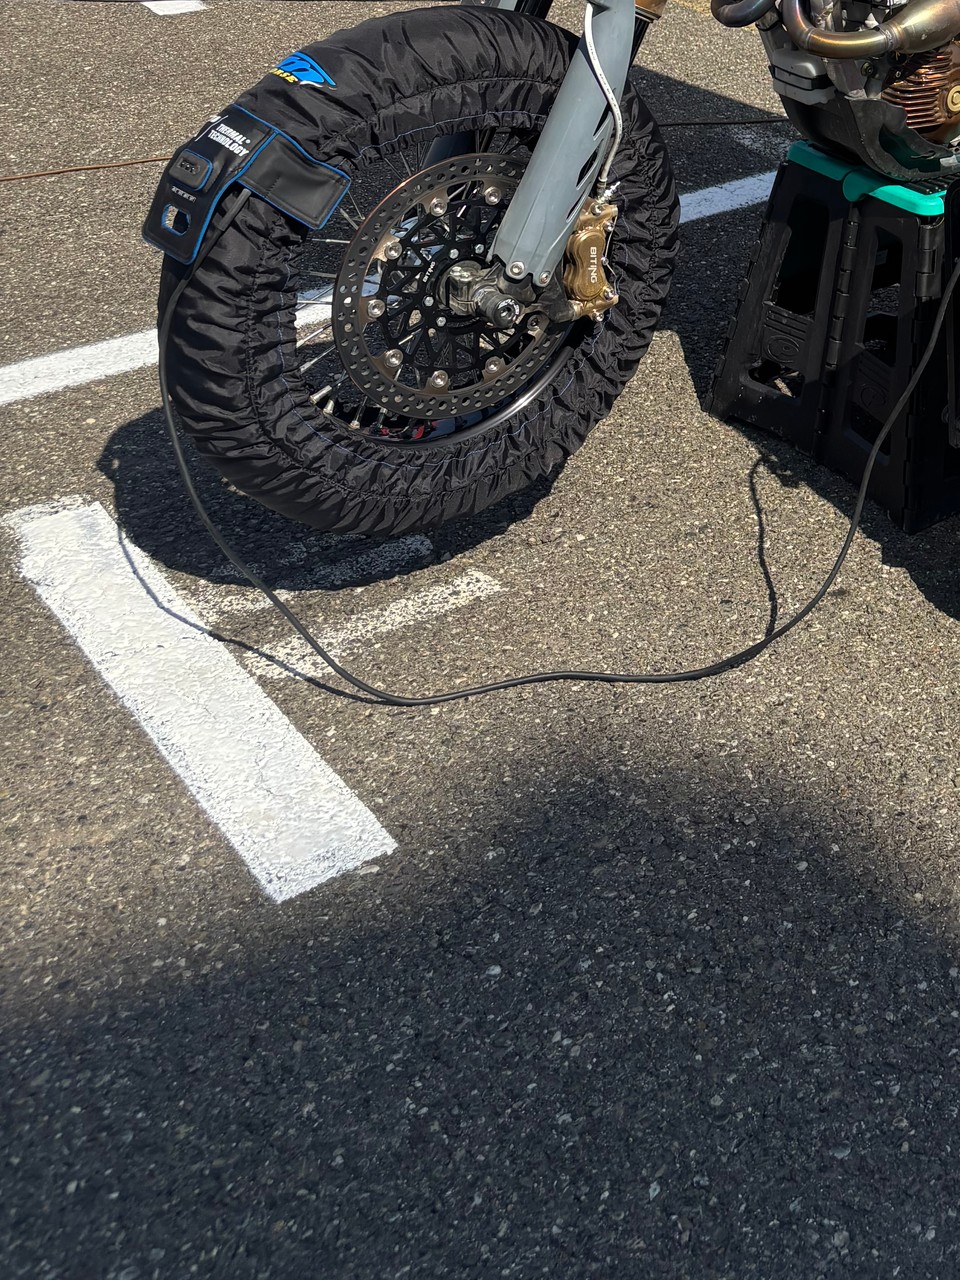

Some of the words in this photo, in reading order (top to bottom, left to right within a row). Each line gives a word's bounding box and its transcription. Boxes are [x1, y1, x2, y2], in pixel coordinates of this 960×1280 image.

[208, 130, 250, 158] TECHNOLOGY
[215, 123, 245, 145] THERMAL
[588, 246, 598, 284] BITING
